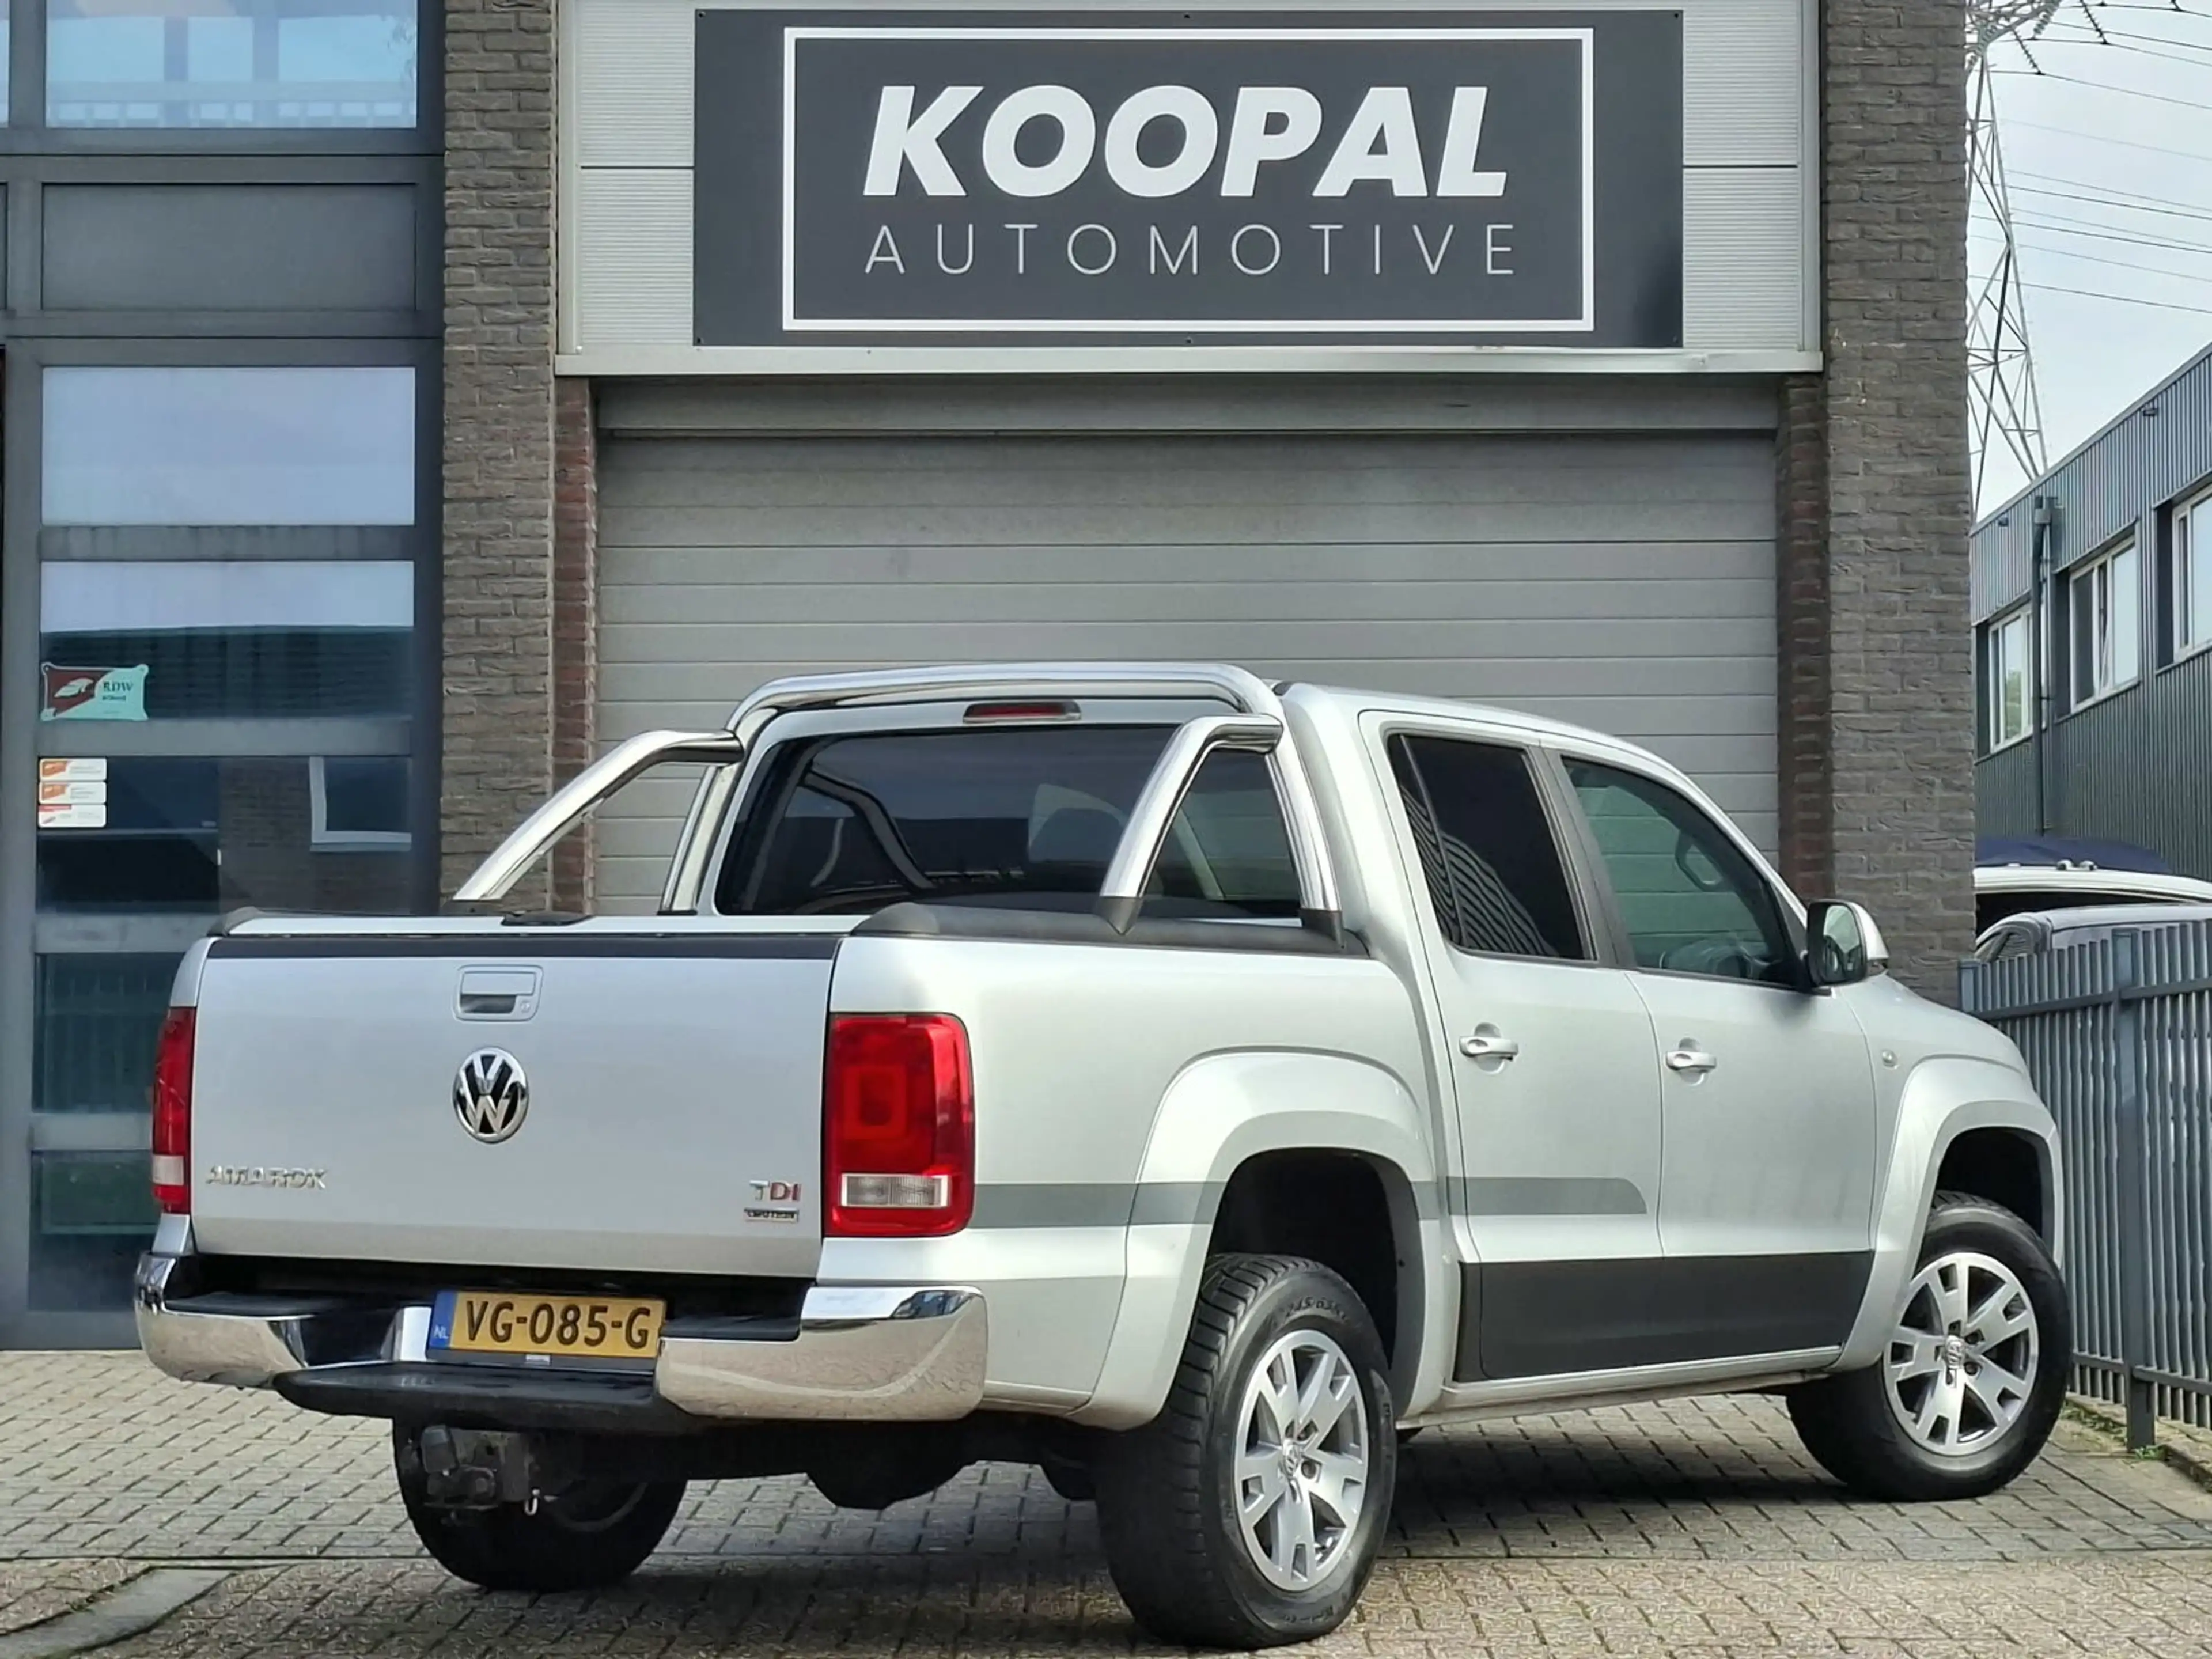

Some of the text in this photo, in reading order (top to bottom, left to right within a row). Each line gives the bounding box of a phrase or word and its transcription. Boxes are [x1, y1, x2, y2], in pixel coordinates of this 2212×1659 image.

[863, 85, 1507, 197] KOOPAL
[865, 224, 1514, 275] AUTOMOTIVE
[103, 680, 133, 692] RDW
[205, 1165, 328, 1190] AMAROK
[749, 1179, 802, 1202] TDI
[433, 1300, 652, 1349] NL VG-085-G
